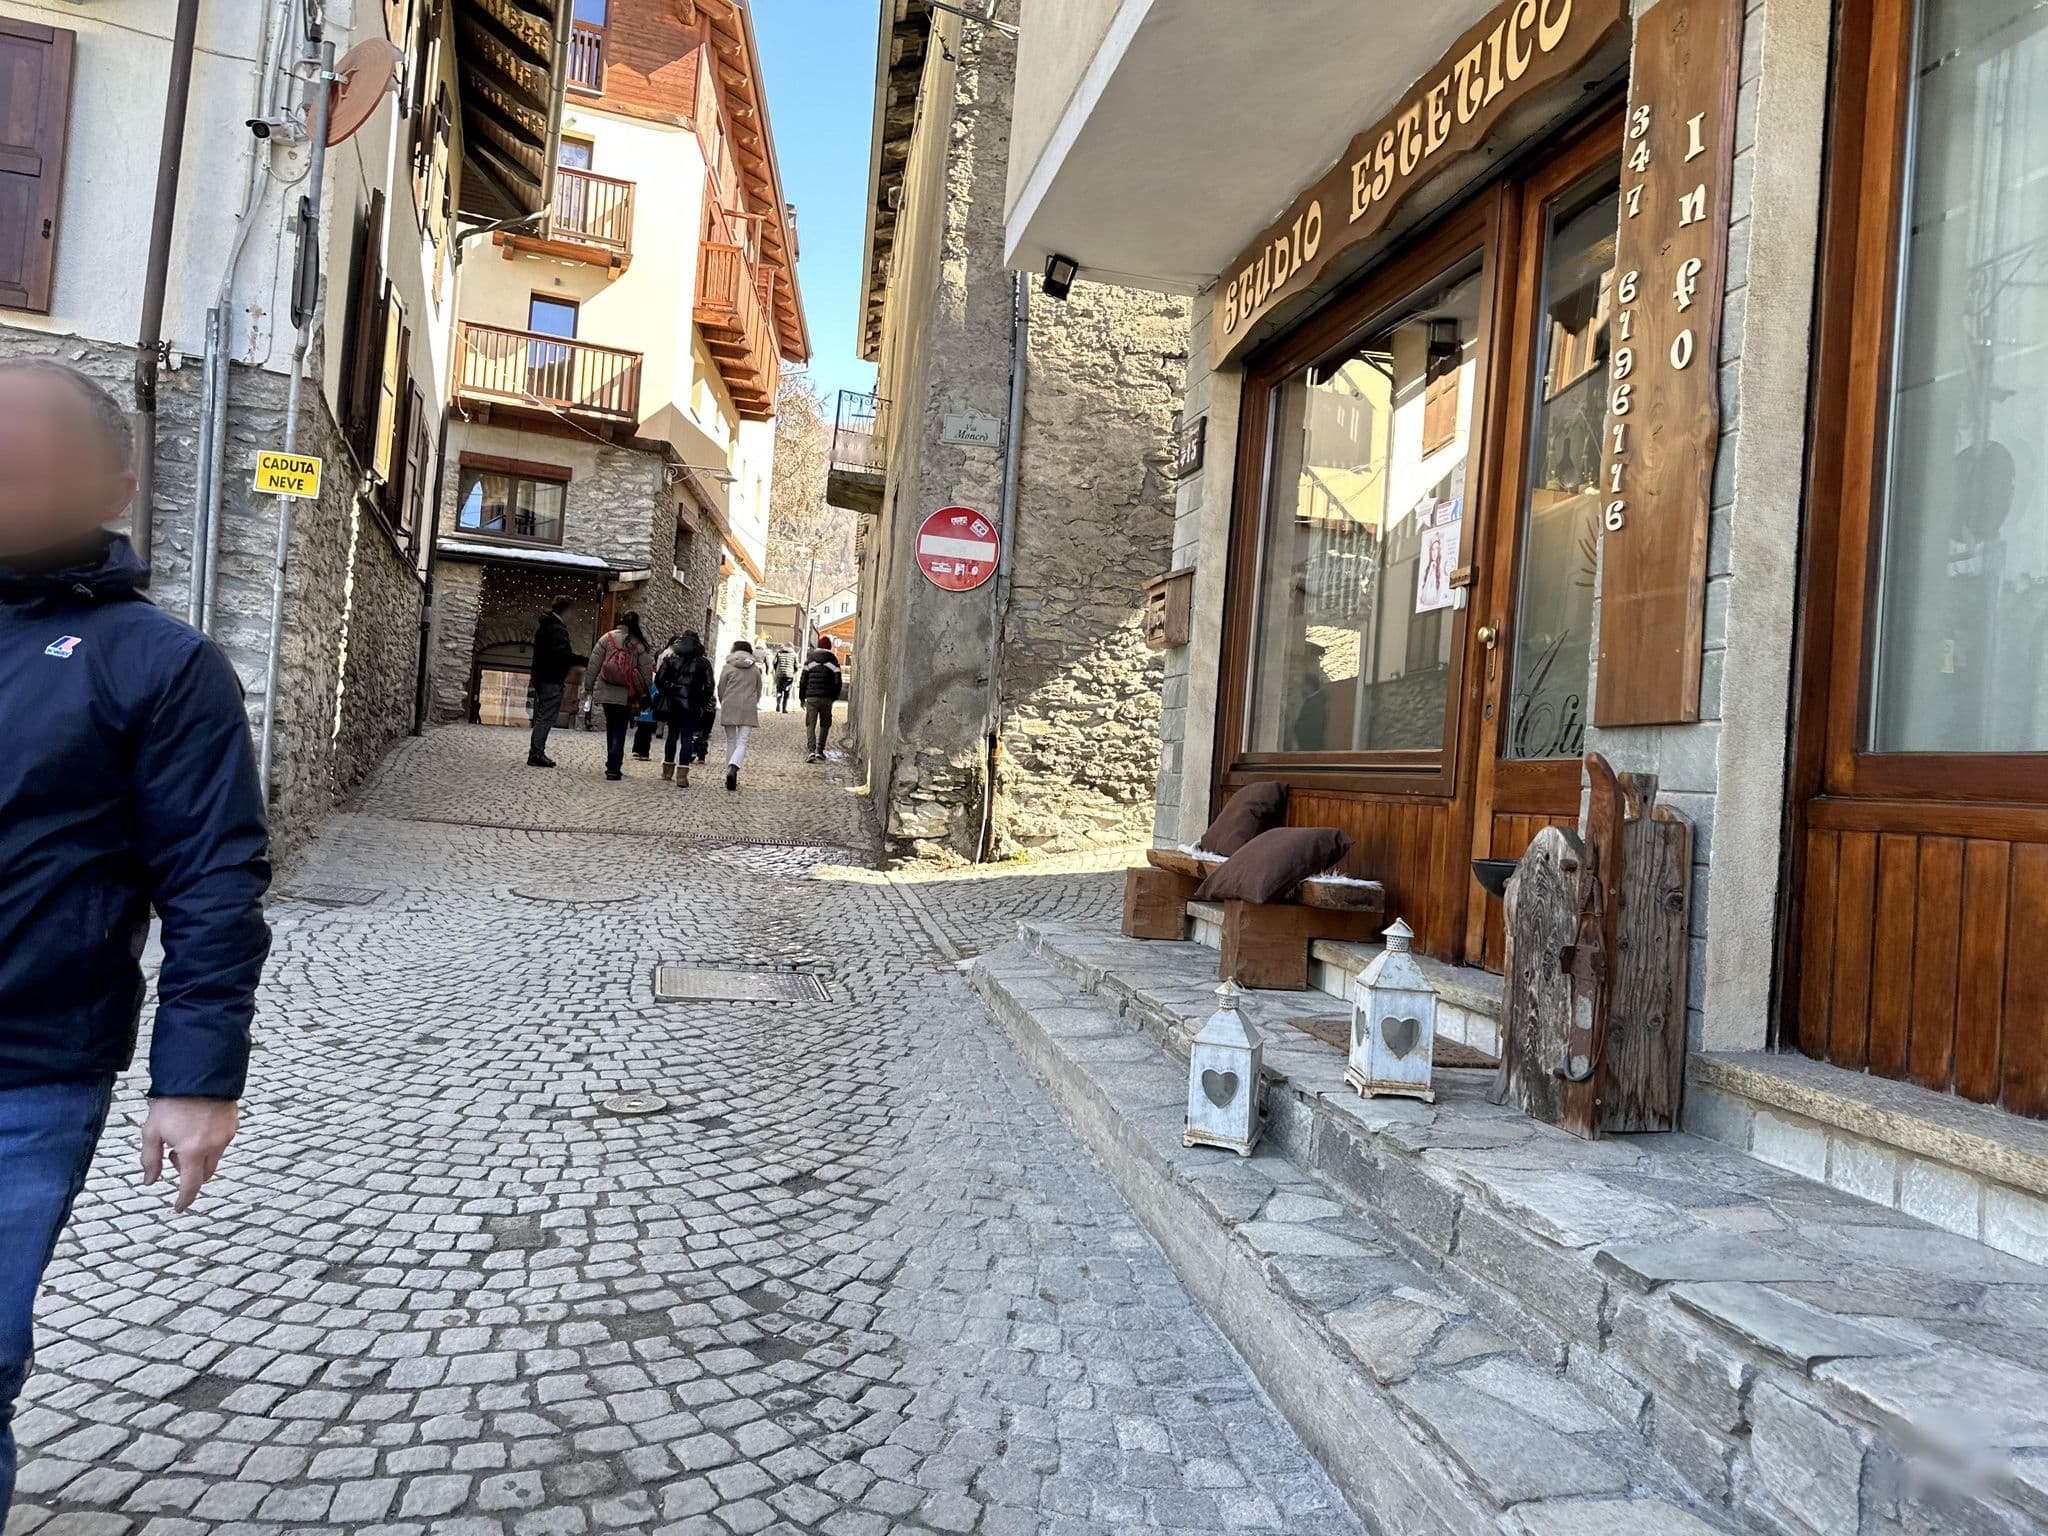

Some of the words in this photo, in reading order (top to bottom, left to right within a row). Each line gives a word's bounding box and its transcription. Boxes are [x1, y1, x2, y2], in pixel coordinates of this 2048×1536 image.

[1223, 200, 1322, 335] STUDIO
[1348, 0, 1573, 225] ESTETICO
[1626, 104, 1651, 219] 347
[1669, 111, 1707, 371] Info
[965, 423, 977, 432] Via
[1604, 270, 1640, 532] 6196116
[262, 456, 315, 475] CADUTA
[268, 474, 305, 491] NEVE
